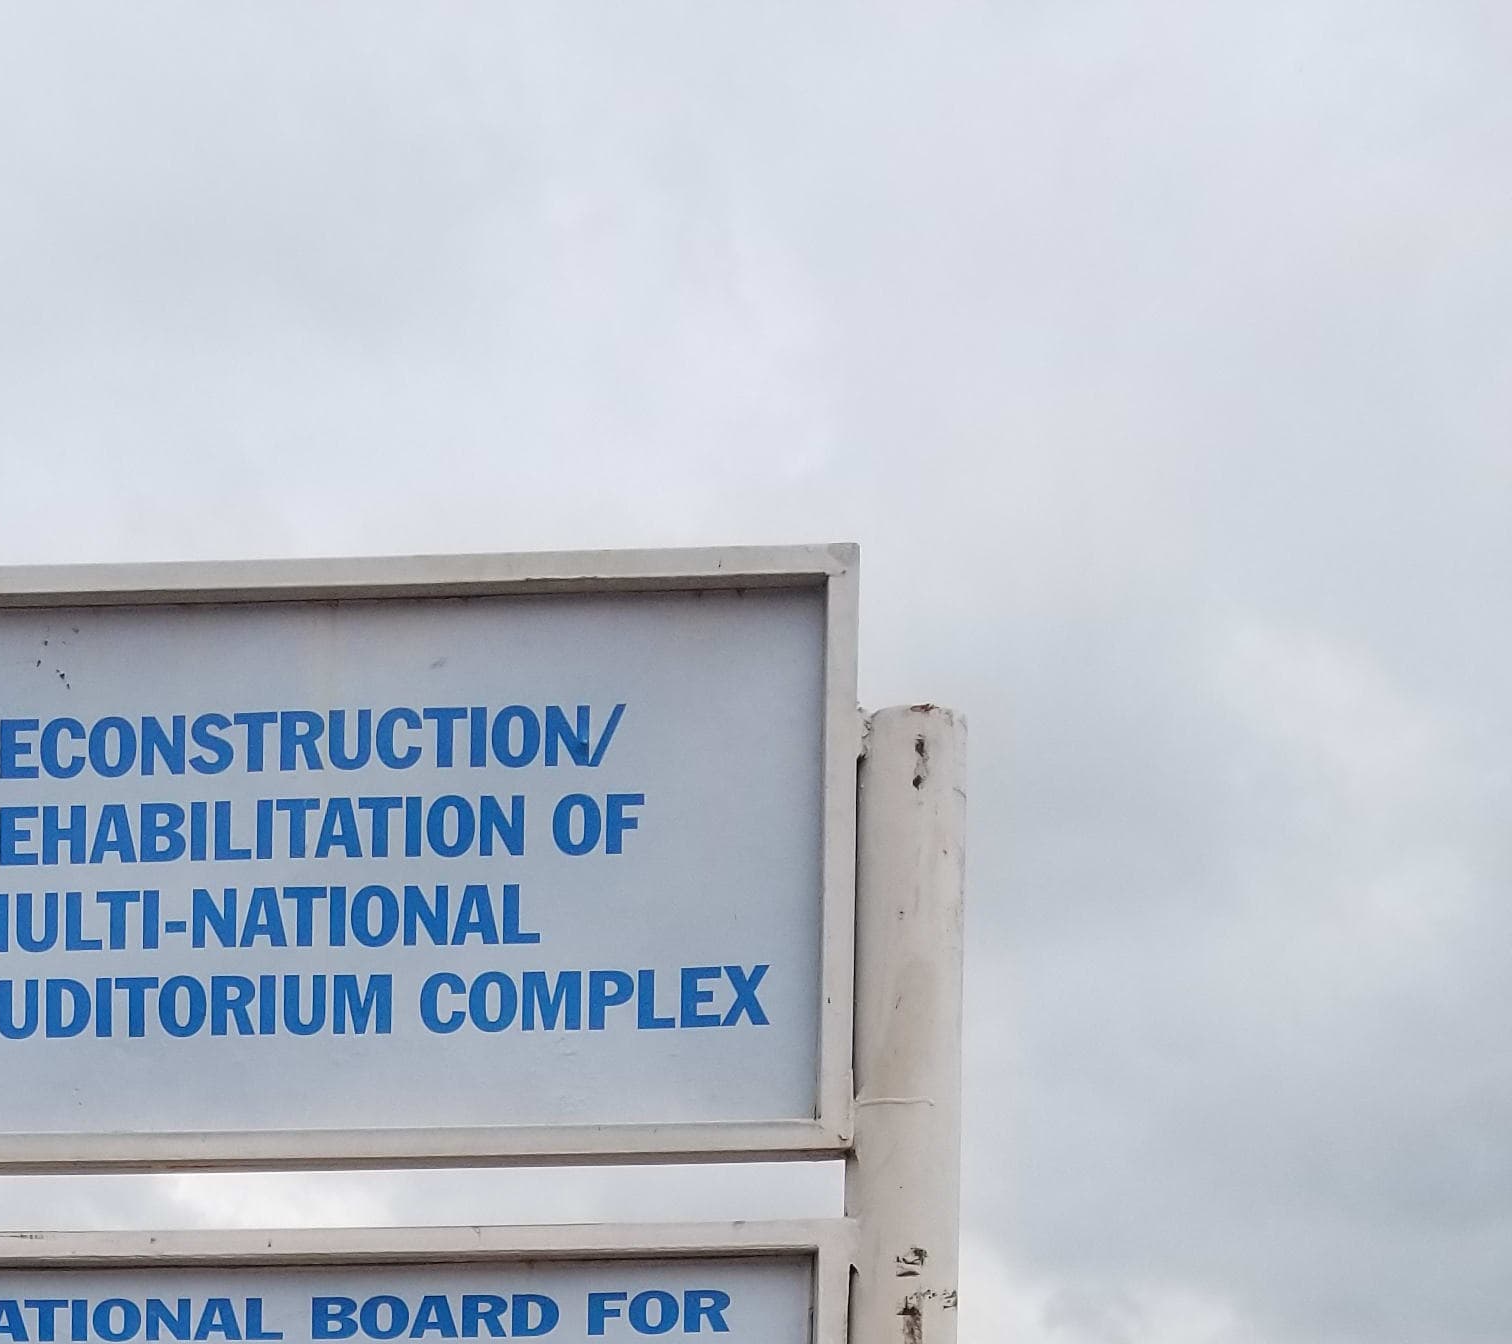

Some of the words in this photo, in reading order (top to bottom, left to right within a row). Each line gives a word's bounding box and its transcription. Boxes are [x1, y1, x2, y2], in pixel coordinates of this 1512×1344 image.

[553, 794, 644, 855] OF
[420, 965, 769, 1033] COMPLEX
[312, 1294, 559, 1339] BOARD
[588, 1290, 730, 1335] FOR
